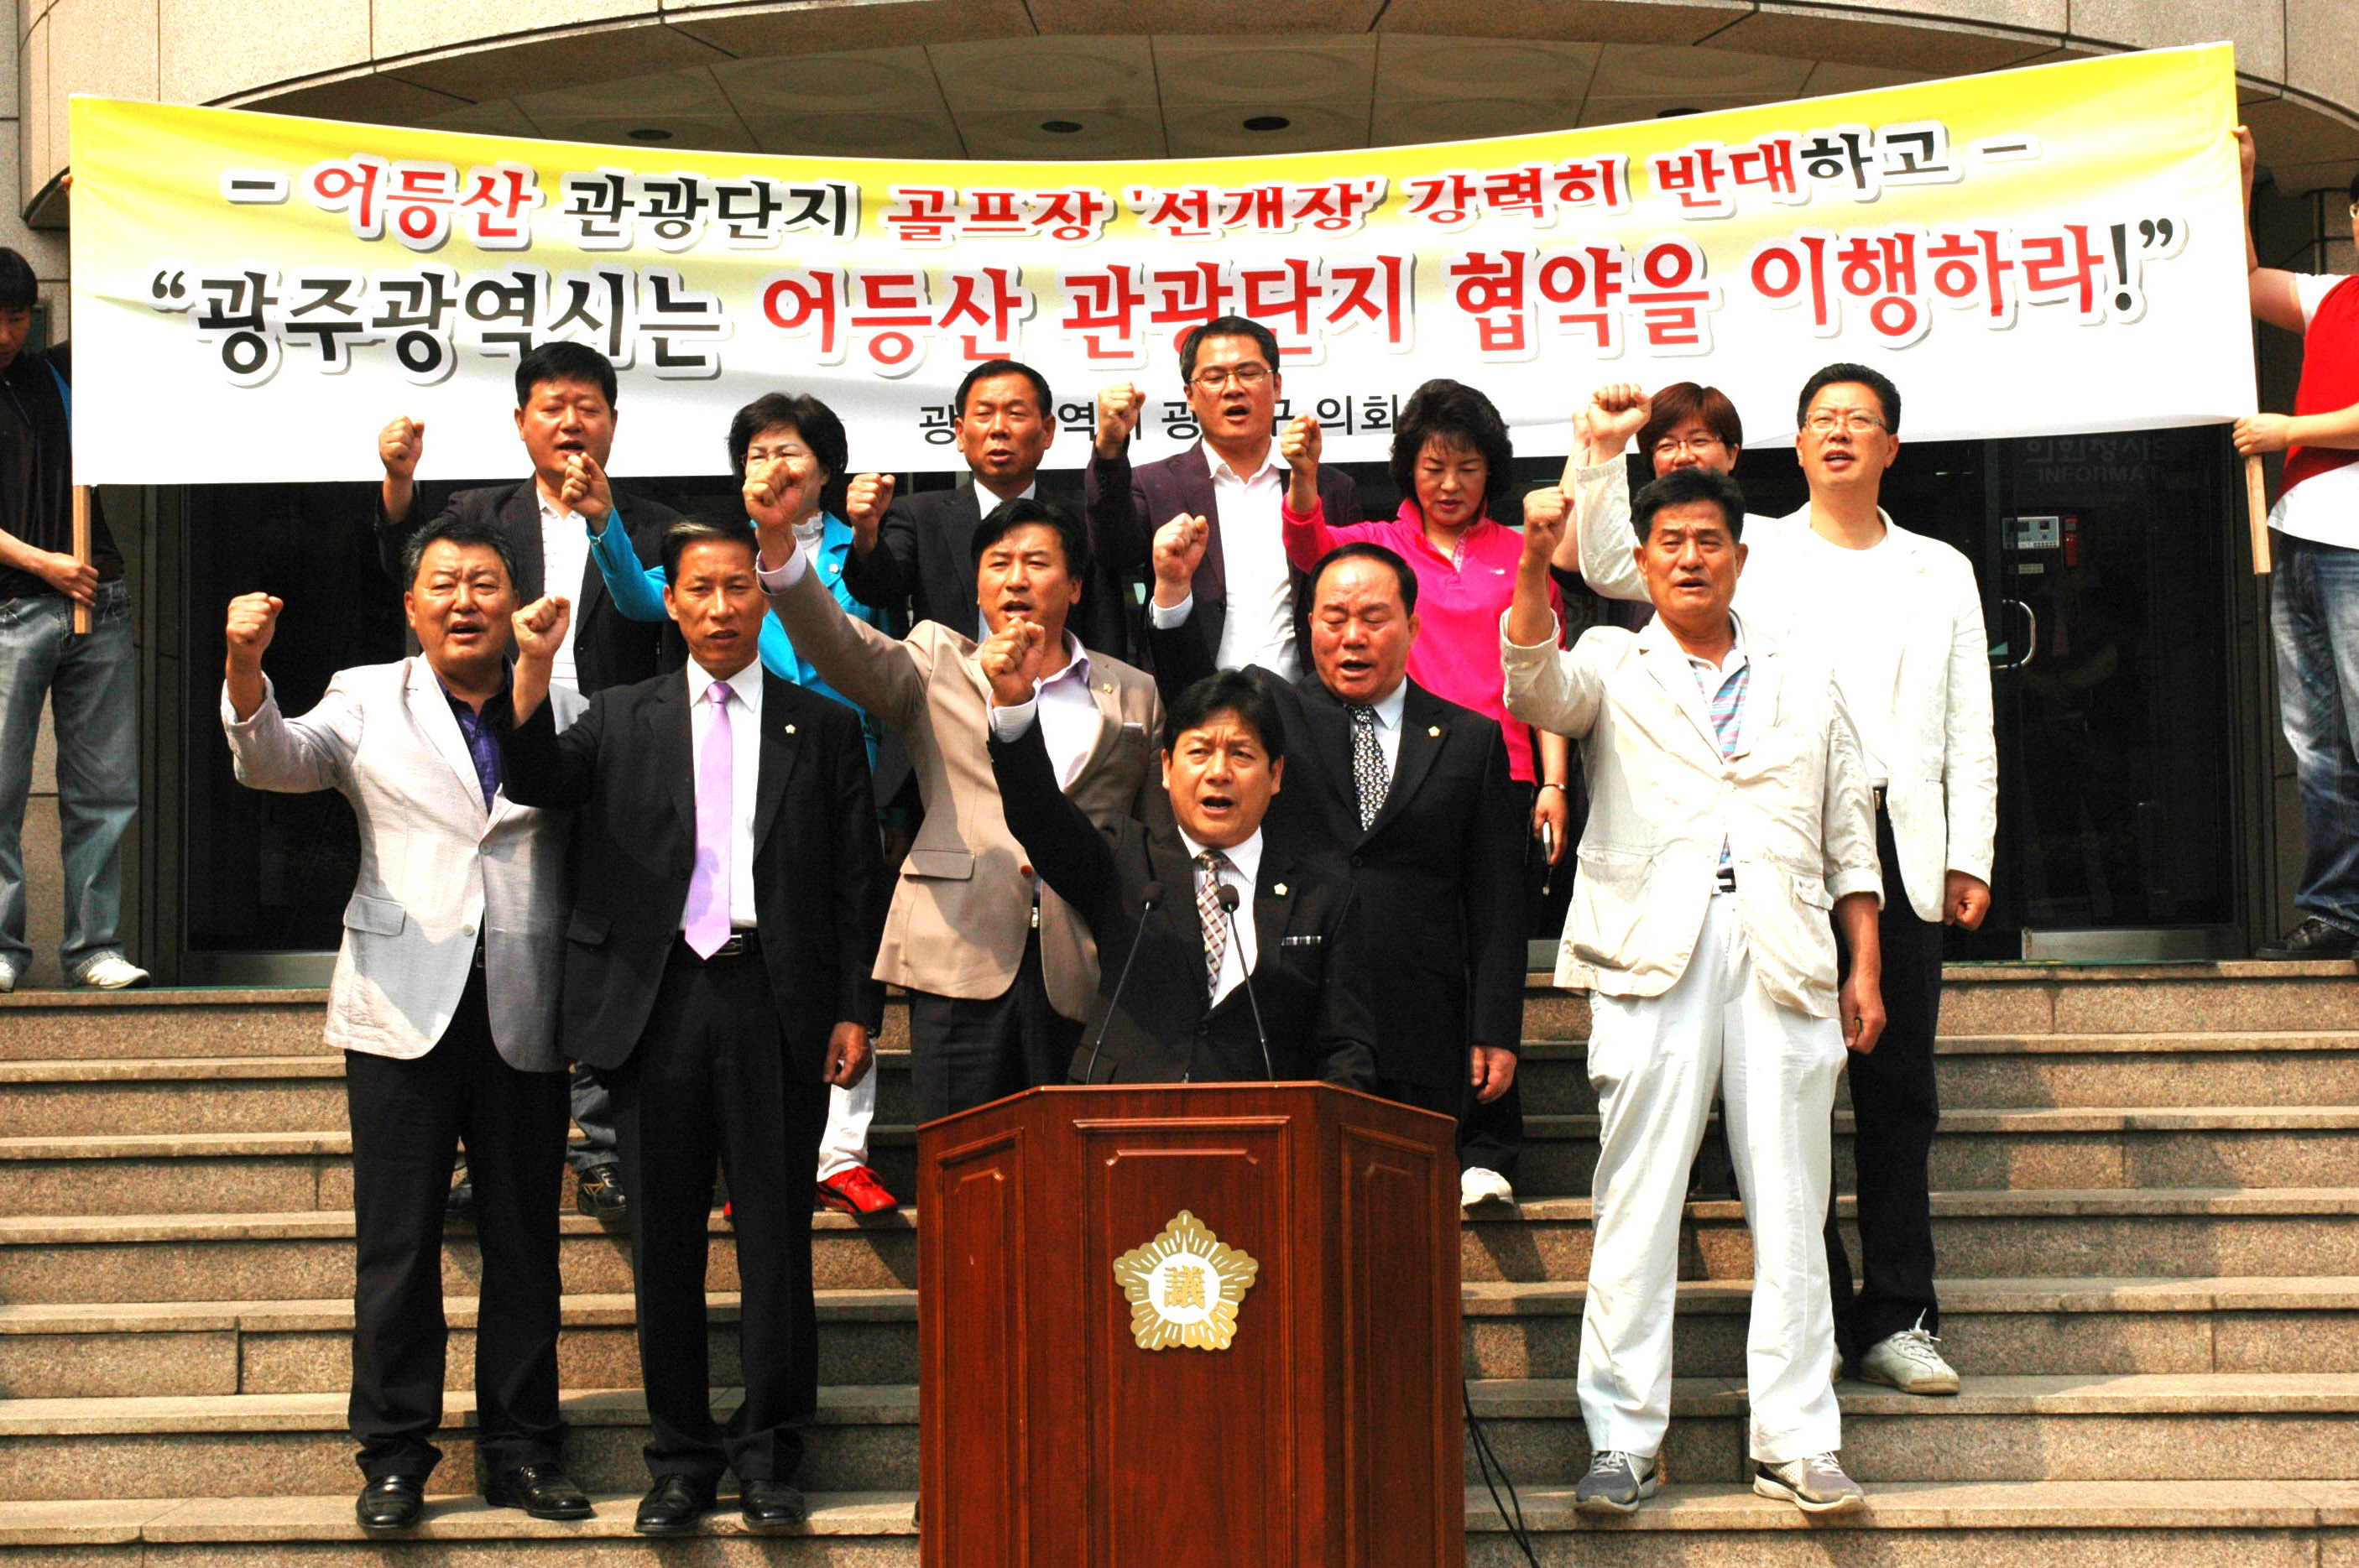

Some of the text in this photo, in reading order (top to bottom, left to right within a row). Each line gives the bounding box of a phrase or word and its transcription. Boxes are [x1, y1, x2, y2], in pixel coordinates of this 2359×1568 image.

[314, 164, 532, 239] 어등산
[565, 174, 847, 239] 관광단지
[888, 189, 1104, 241] 골프장
[1409, 159, 1616, 223] 강력히
[1657, 131, 1950, 207] 반대하고
[763, 267, 1022, 365] 어등산
[1063, 254, 1401, 361] 관광단지
[1450, 244, 1709, 351] 협약을
[1161, 399, 1296, 440] 광구
[1316, 394, 1398, 435] 의회
